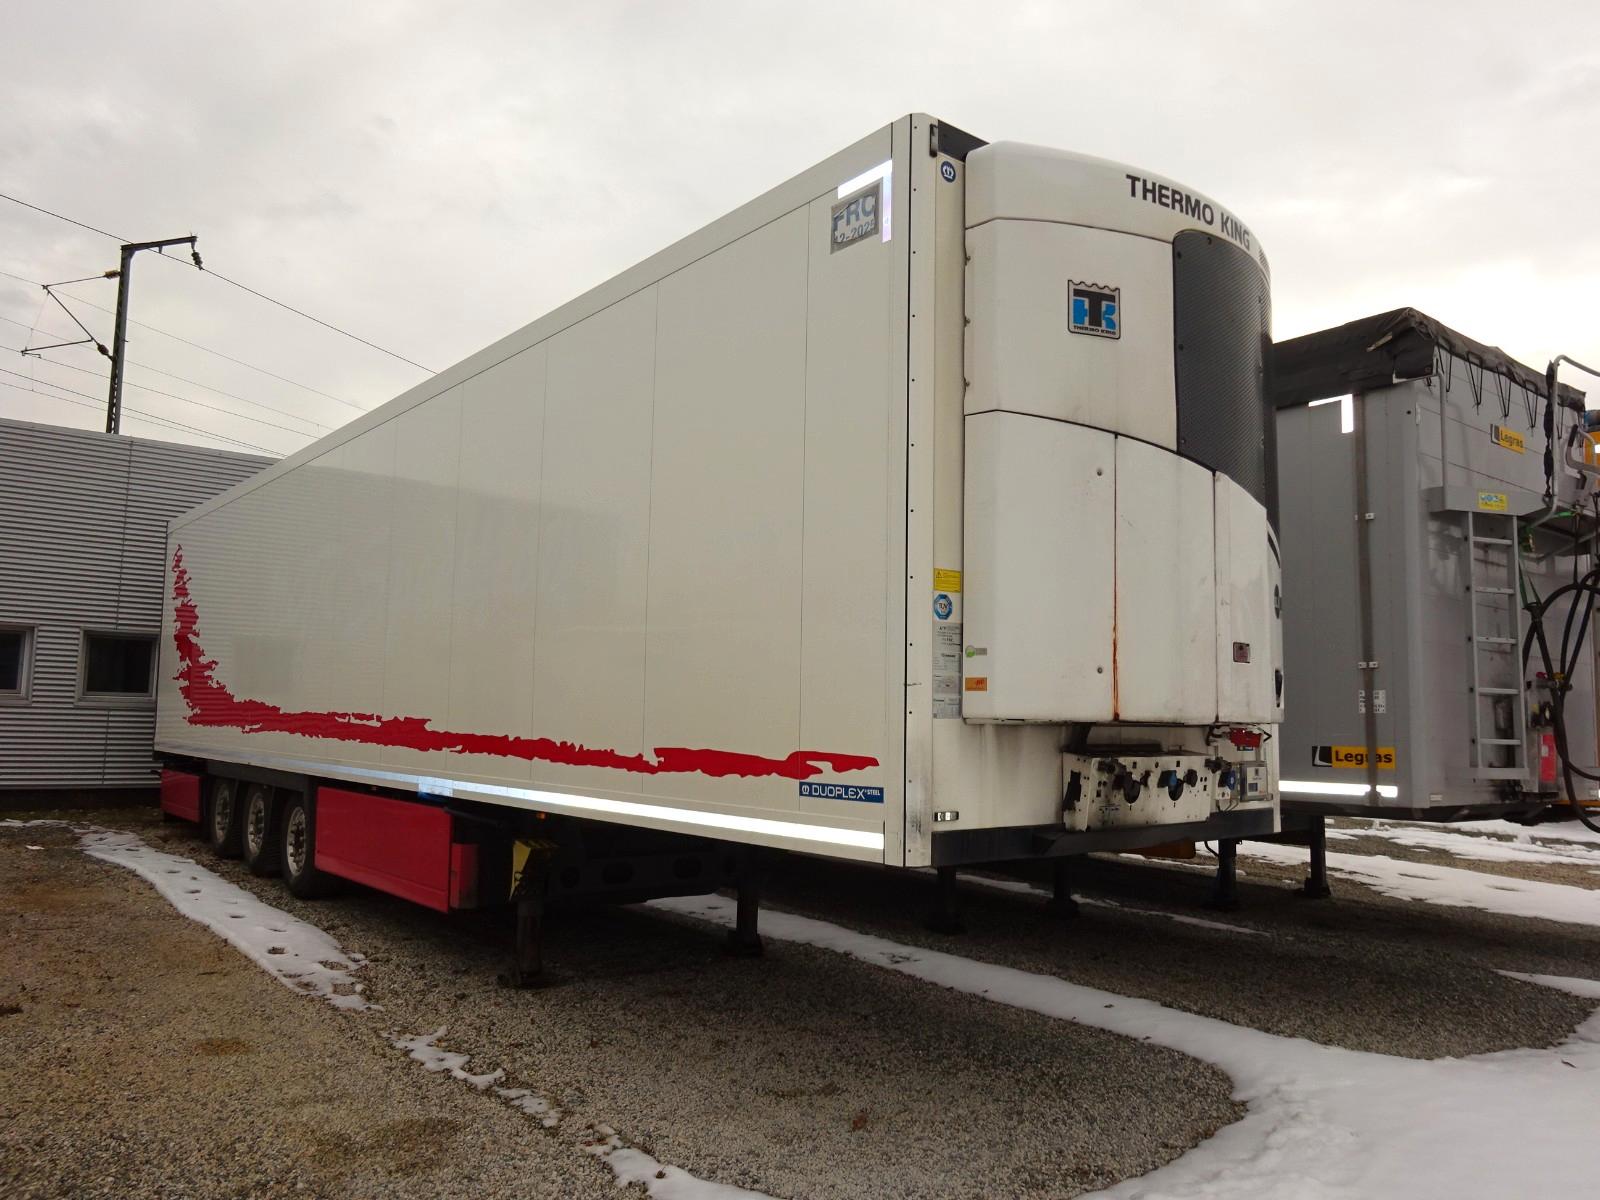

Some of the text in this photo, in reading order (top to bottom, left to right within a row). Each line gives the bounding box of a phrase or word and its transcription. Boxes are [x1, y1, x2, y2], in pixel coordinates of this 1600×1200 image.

[833, 194, 876, 231] FRC
[1126, 173, 1250, 251] THERMO KING
[812, 785, 865, 799] DUOPLEX
